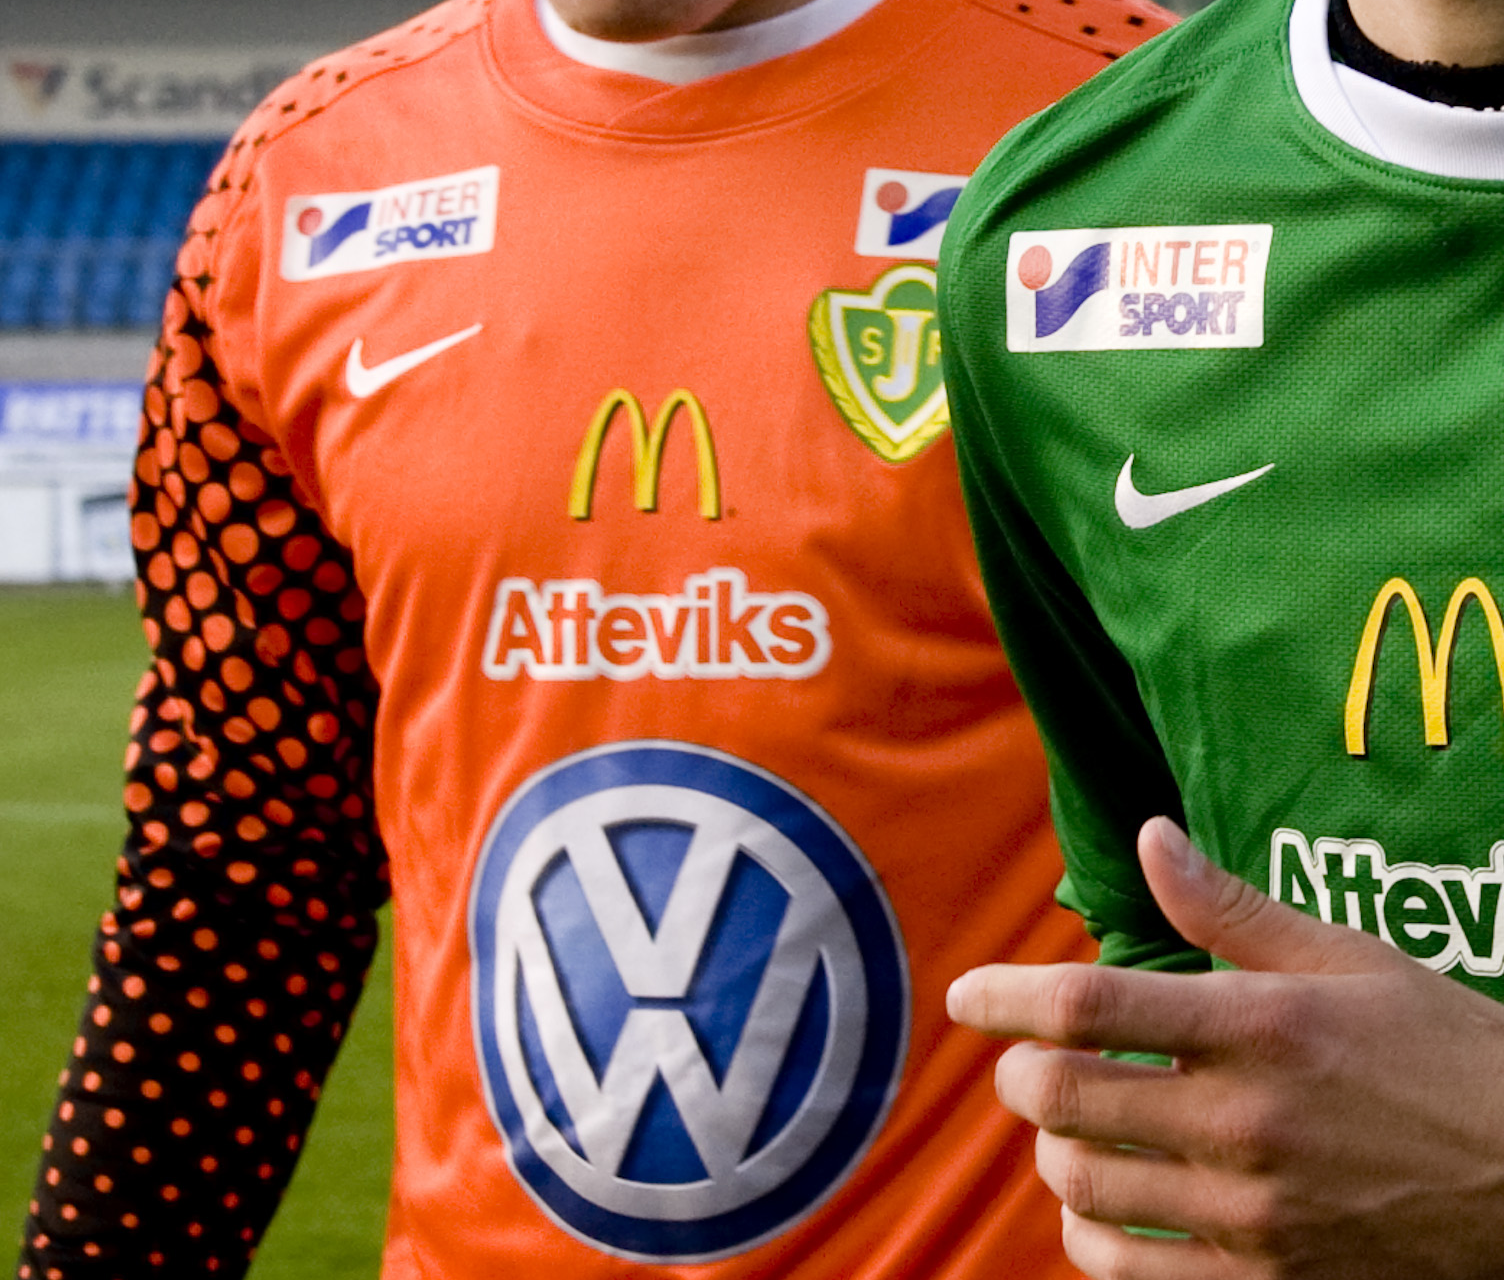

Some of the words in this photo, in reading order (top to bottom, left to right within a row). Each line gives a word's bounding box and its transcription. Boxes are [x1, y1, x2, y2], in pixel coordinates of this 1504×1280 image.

[377, 181, 481, 227] INTER
[374, 215, 479, 258] SPORT
[1119, 238, 1249, 288] INTER
[1118, 290, 1247, 338] SPORT
[490, 576, 825, 671] Atteviks
